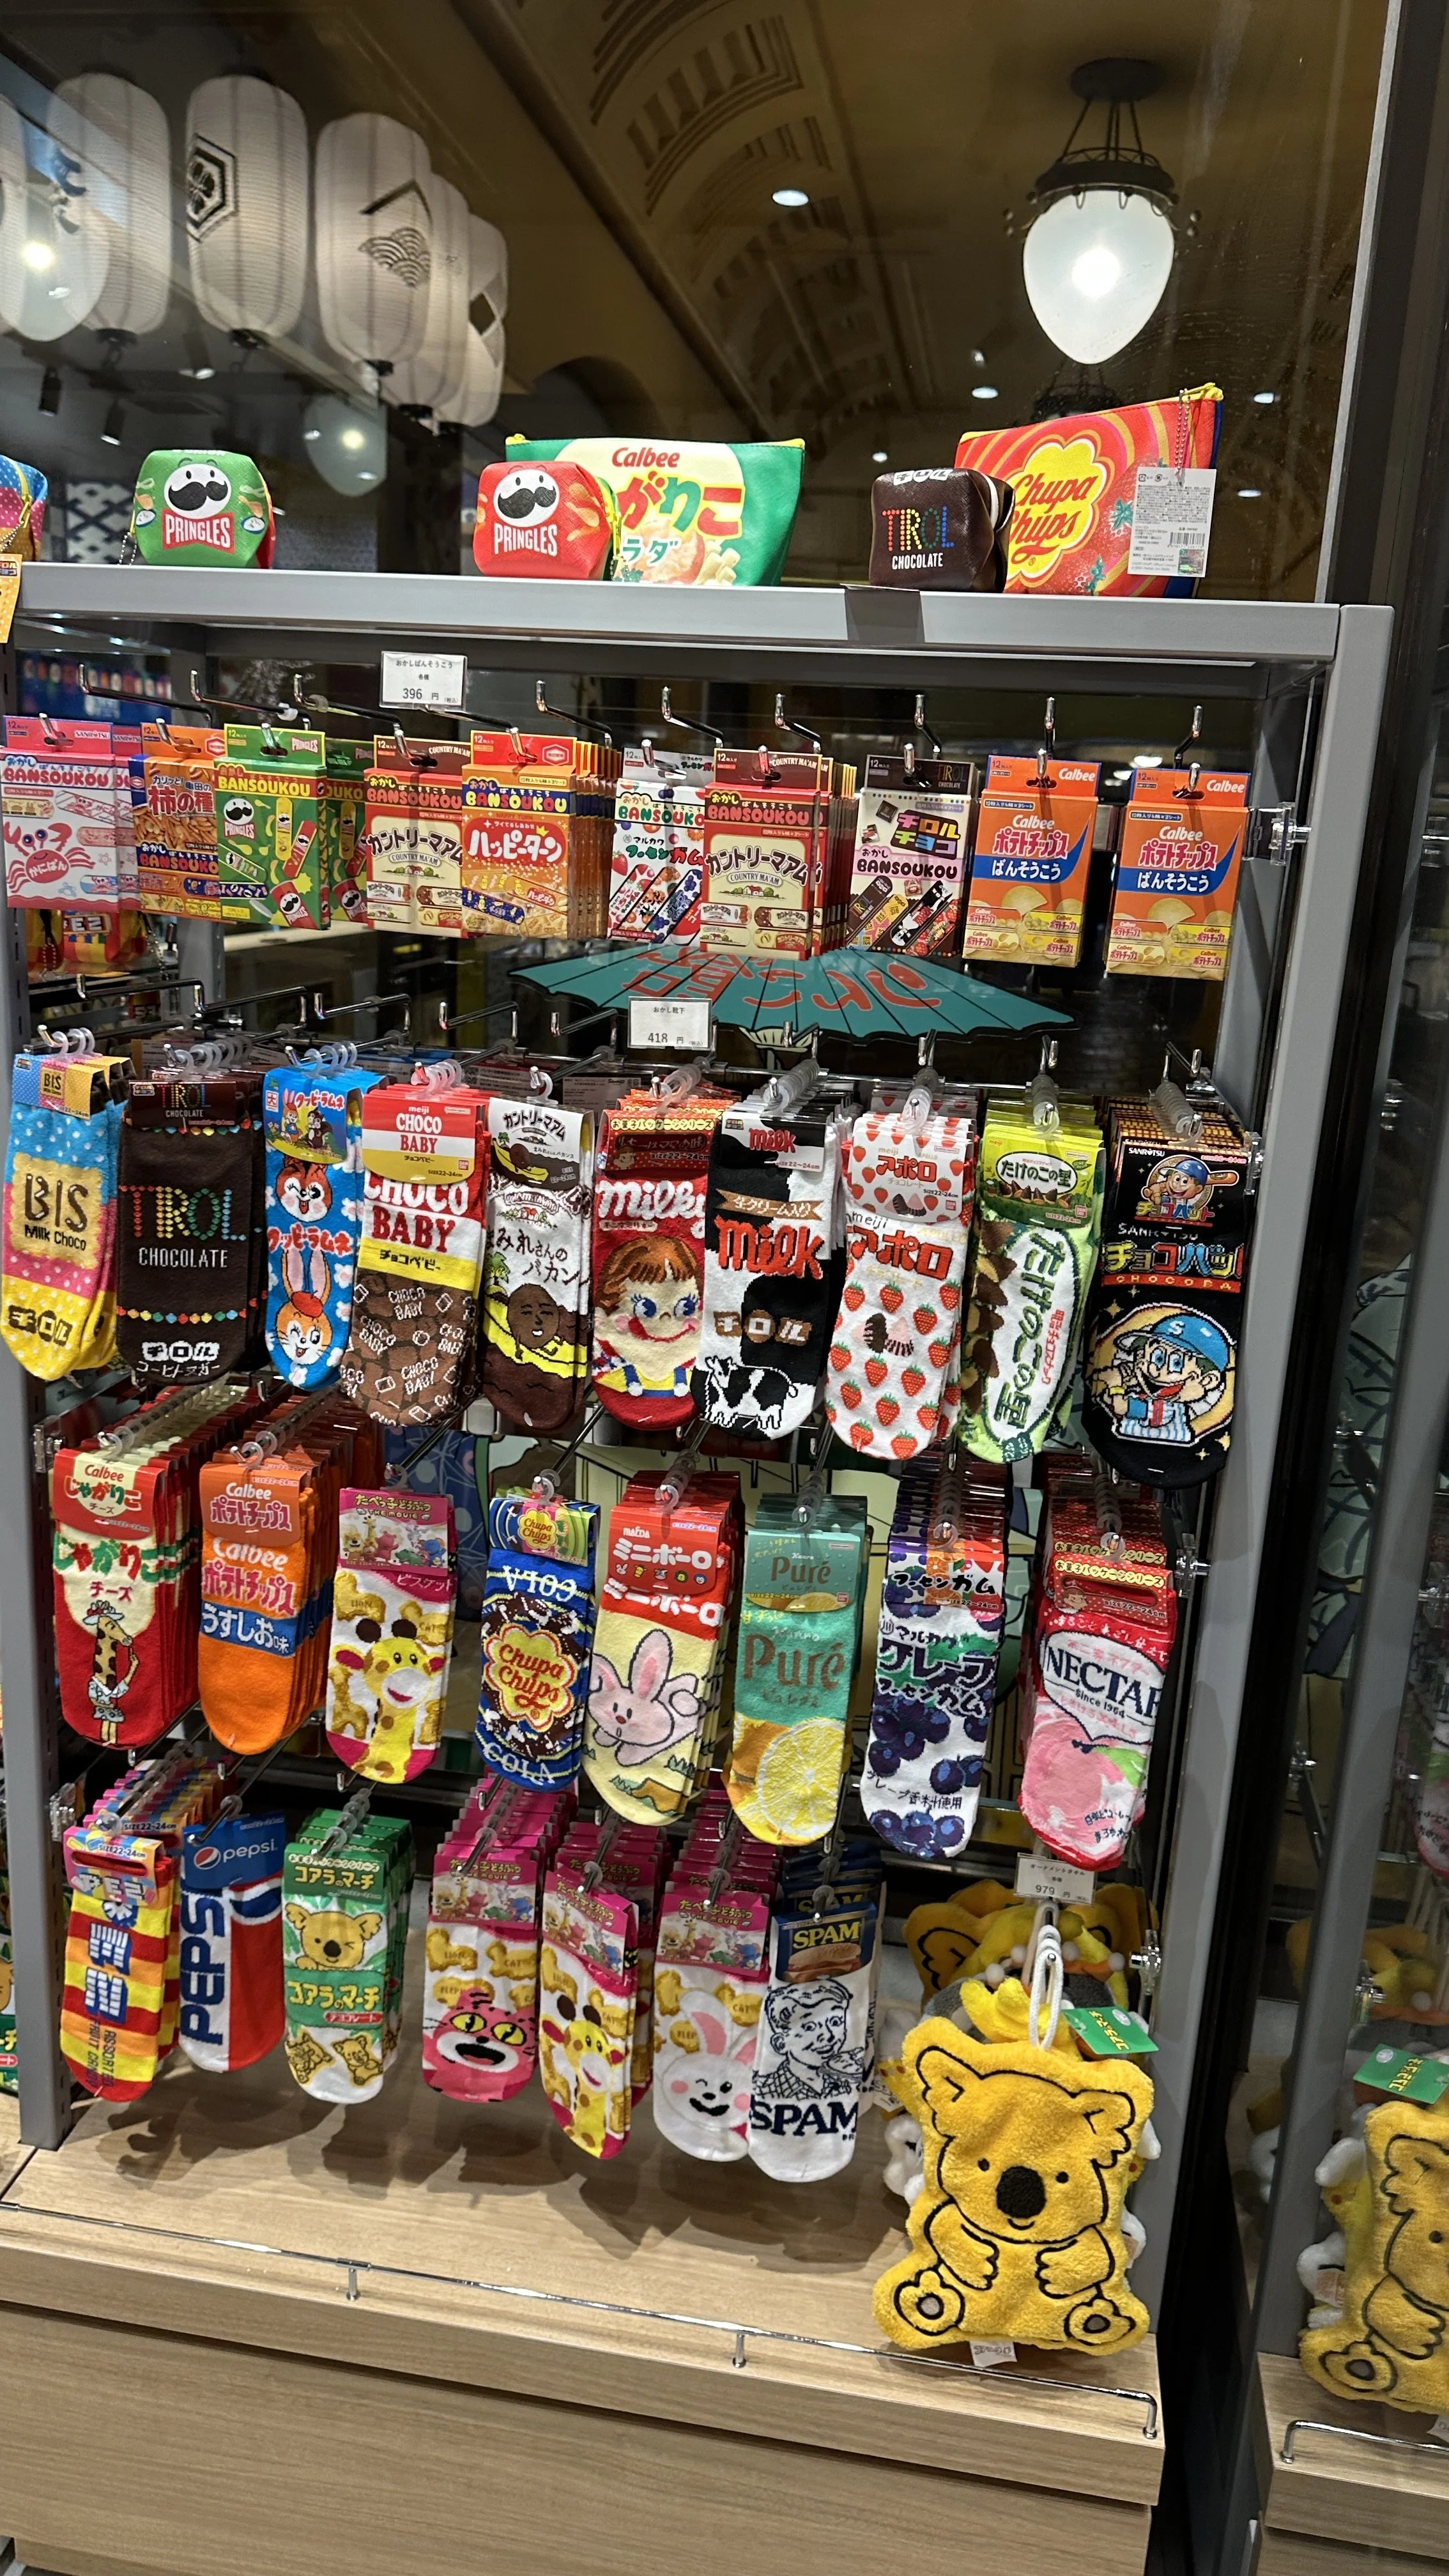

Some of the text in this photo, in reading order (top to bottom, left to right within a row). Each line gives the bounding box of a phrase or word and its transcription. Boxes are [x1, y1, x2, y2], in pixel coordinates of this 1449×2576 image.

[612, 447, 680, 468] Calbee
[165, 514, 231, 548] PRINGLES
[493, 523, 558, 556] PRINGLES
[882, 505, 955, 553] TIROL
[891, 553, 944, 570] CHOCOLATE
[395, 659, 452, 669] おかしばんそうこう
[402, 687, 439, 701] 396 円
[291, 739, 319, 753] PRINGLES
[8, 757, 35, 767] おかし
[771, 757, 817, 769] COUNTRY MA'AM
[4, 767, 109, 787] BANSOUKOU
[369, 777, 395, 788] おかし
[470, 780, 497, 792] おかし
[1058, 768, 1096, 782] Calbee
[1206, 779, 1245, 793] Calbee
[218, 776, 310, 797] BANSOUKOU
[500, 788, 550, 798] ばんそうこう
[148, 786, 215, 816] 柿の種
[367, 788, 462, 810] BANSOUKOU
[465, 791, 568, 813] BANSOUKOU
[622, 794, 649, 806] おかし
[711, 793, 739, 804] おかし
[742, 801, 793, 811] ばんそうこう
[708, 805, 810, 825] BANSOUKOU
[897, 811, 961, 839] チロル
[1012, 814, 1055, 829] Calbee
[224, 823, 256, 838] PRINGLES
[632, 836, 664, 846] マルカワ
[1158, 825, 1204, 841] Calbee
[141, 843, 165, 853] おかし
[468, 829, 562, 862] ハッピーターン
[862, 848, 889, 859] おかし
[894, 830, 957, 855] チョコ
[992, 826, 1070, 859] ポテトチップス
[392, 852, 418, 862] COUNTRY
[625, 843, 703, 866] フーセンガム
[705, 845, 808, 886] カントリーマアム
[1138, 838, 1218, 871] ポテトチップス
[730, 873, 758, 882] COUNTRY
[857, 859, 958, 880] BANSOUKOU
[992, 859, 1062, 881] ばんそうこう
[1137, 873, 1209, 893] ばんそうこう
[968, 913, 997, 926] ポテトチップス
[966, 936, 993, 948] ポテトチップス
[654, 1006, 685, 1015] おかし靴下
[648, 1032, 684, 1045] 418 円
[43, 1073, 62, 1091] BIS
[157, 1084, 211, 1108] TIROL
[294, 1089, 345, 1112] クッピーラムネ
[165, 1110, 203, 1118] CHOCOLATE
[408, 1105, 430, 1114] meiji
[395, 1112, 442, 1135] CHOCO
[503, 1109, 567, 1142] カントリーマアム
[611, 1119, 714, 1131] お菓子パッケージシリーズ
[399, 1134, 439, 1154] BABY
[875, 1155, 938, 1183] アポロ
[1000, 1159, 1072, 1188] たけのこの里
[887, 1177, 925, 1188] チョコレート
[24, 1173, 89, 1233] BIS
[364, 1174, 470, 1216] CHOCO
[118, 1184, 247, 1241] TIROL
[1135, 1200, 1216, 1222] チョコバット
[24, 1224, 87, 1251] Milk Choco
[266, 1224, 352, 1254] クッピーラムネ
[371, 1204, 456, 1253] BABY
[138, 1246, 229, 1269] CHOCOLATE
[379, 1249, 441, 1271] チョコベビー
[850, 1226, 954, 1280] アポロ
[388, 1287, 426, 1304] CHOCO
[394, 1301, 423, 1321] BABY
[8, 1305, 74, 1345] チロル
[360, 1315, 397, 1347] CHOCO
[713, 1308, 813, 1346] チロル
[994, 1233, 1066, 1430] たけのこの里
[1167, 1320, 1186, 1336] S
[141, 1341, 220, 1362] チロル
[358, 1328, 388, 1356] BABY
[401, 1356, 439, 1380] CHOCO
[84, 1464, 125, 1482] Calbee
[65, 1475, 142, 1512] じゃがりこ
[225, 1482, 272, 1501] Calbee
[355, 1492, 432, 1512] たべっ子どうぶつ
[89, 1502, 114, 1515] チーズ
[210, 1495, 293, 1532] ポテトチップス
[367, 1508, 387, 1517] THE
[523, 1518, 553, 1532] Chupa
[623, 1526, 650, 1540] MAEDA
[521, 1529, 553, 1544] Chups
[53, 1532, 160, 1584] じゃがりこ
[212, 1536, 289, 1572] Calbee
[613, 1537, 713, 1570] ミニボーロ
[770, 1556, 832, 1585] Puré
[1055, 1559, 1165, 1588] お菓子パッケージシリーズ
[89, 1580, 133, 1602] チーズ
[201, 1560, 297, 1616] ポテトチップス
[893, 1573, 995, 1595] フーセンガム
[602, 1577, 724, 1627] ミニボーロ
[201, 1604, 289, 1653] うすしお味
[896, 1625, 957, 1650] マルカワ
[498, 1643, 564, 1680] Chupa
[742, 1632, 845, 1691] Puré
[498, 1666, 559, 1703] Chups
[482, 1741, 556, 1787] COLA
[223, 1839, 275, 1863] pepsi
[72, 1873, 145, 1901] PEZ
[295, 1865, 374, 1890] コアラのマーチ
[1035, 1884, 1055, 1896] 979
[792, 1920, 862, 1951] SPAM
[287, 1981, 381, 2011] コアラのマーチ
[750, 2101, 857, 2138] SPAM
